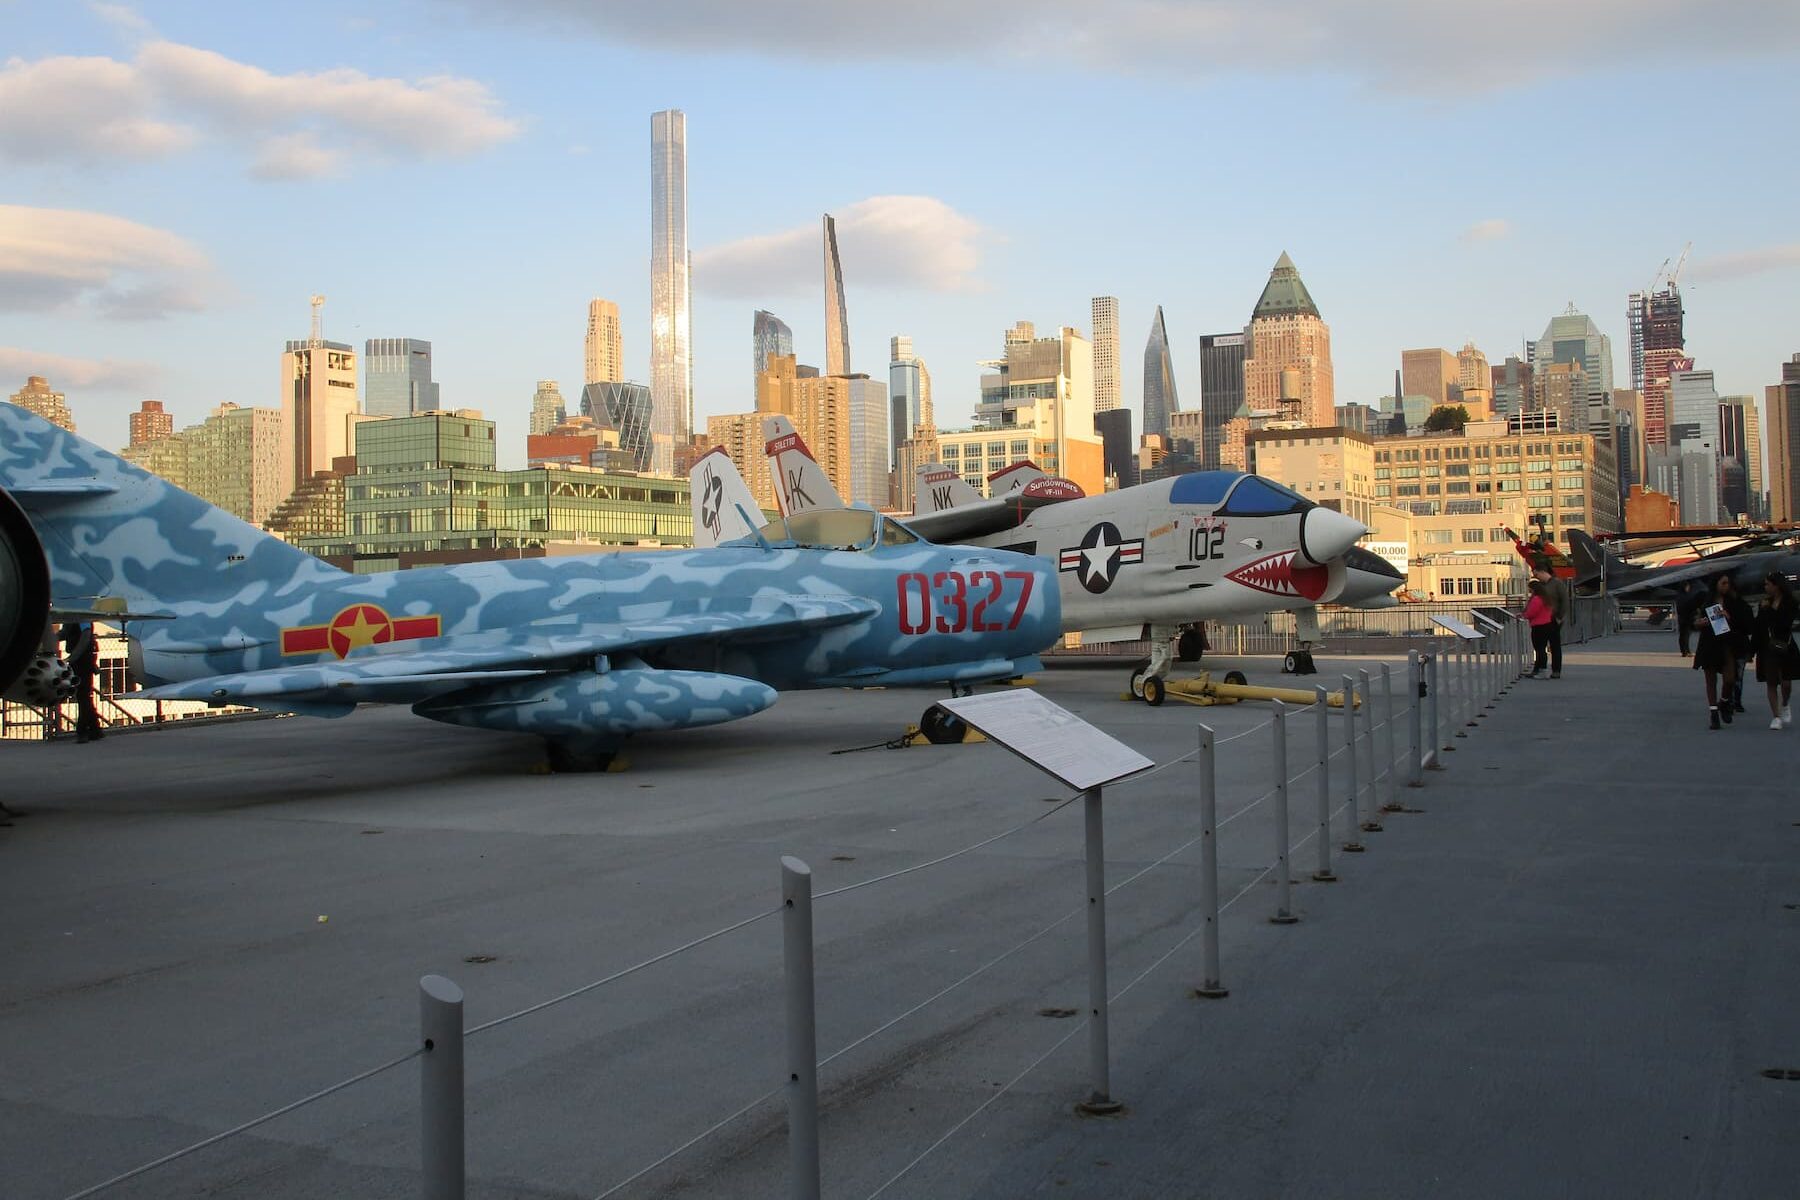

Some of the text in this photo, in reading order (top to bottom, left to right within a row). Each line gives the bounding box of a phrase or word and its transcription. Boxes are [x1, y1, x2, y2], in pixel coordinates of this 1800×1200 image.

[1672, 360, 1687, 370] W
[931, 485, 954, 512] NK
[1030, 479, 1079, 493] Sundowners
[1188, 526, 1226, 561] 102
[896, 570, 1035, 636] 0327
